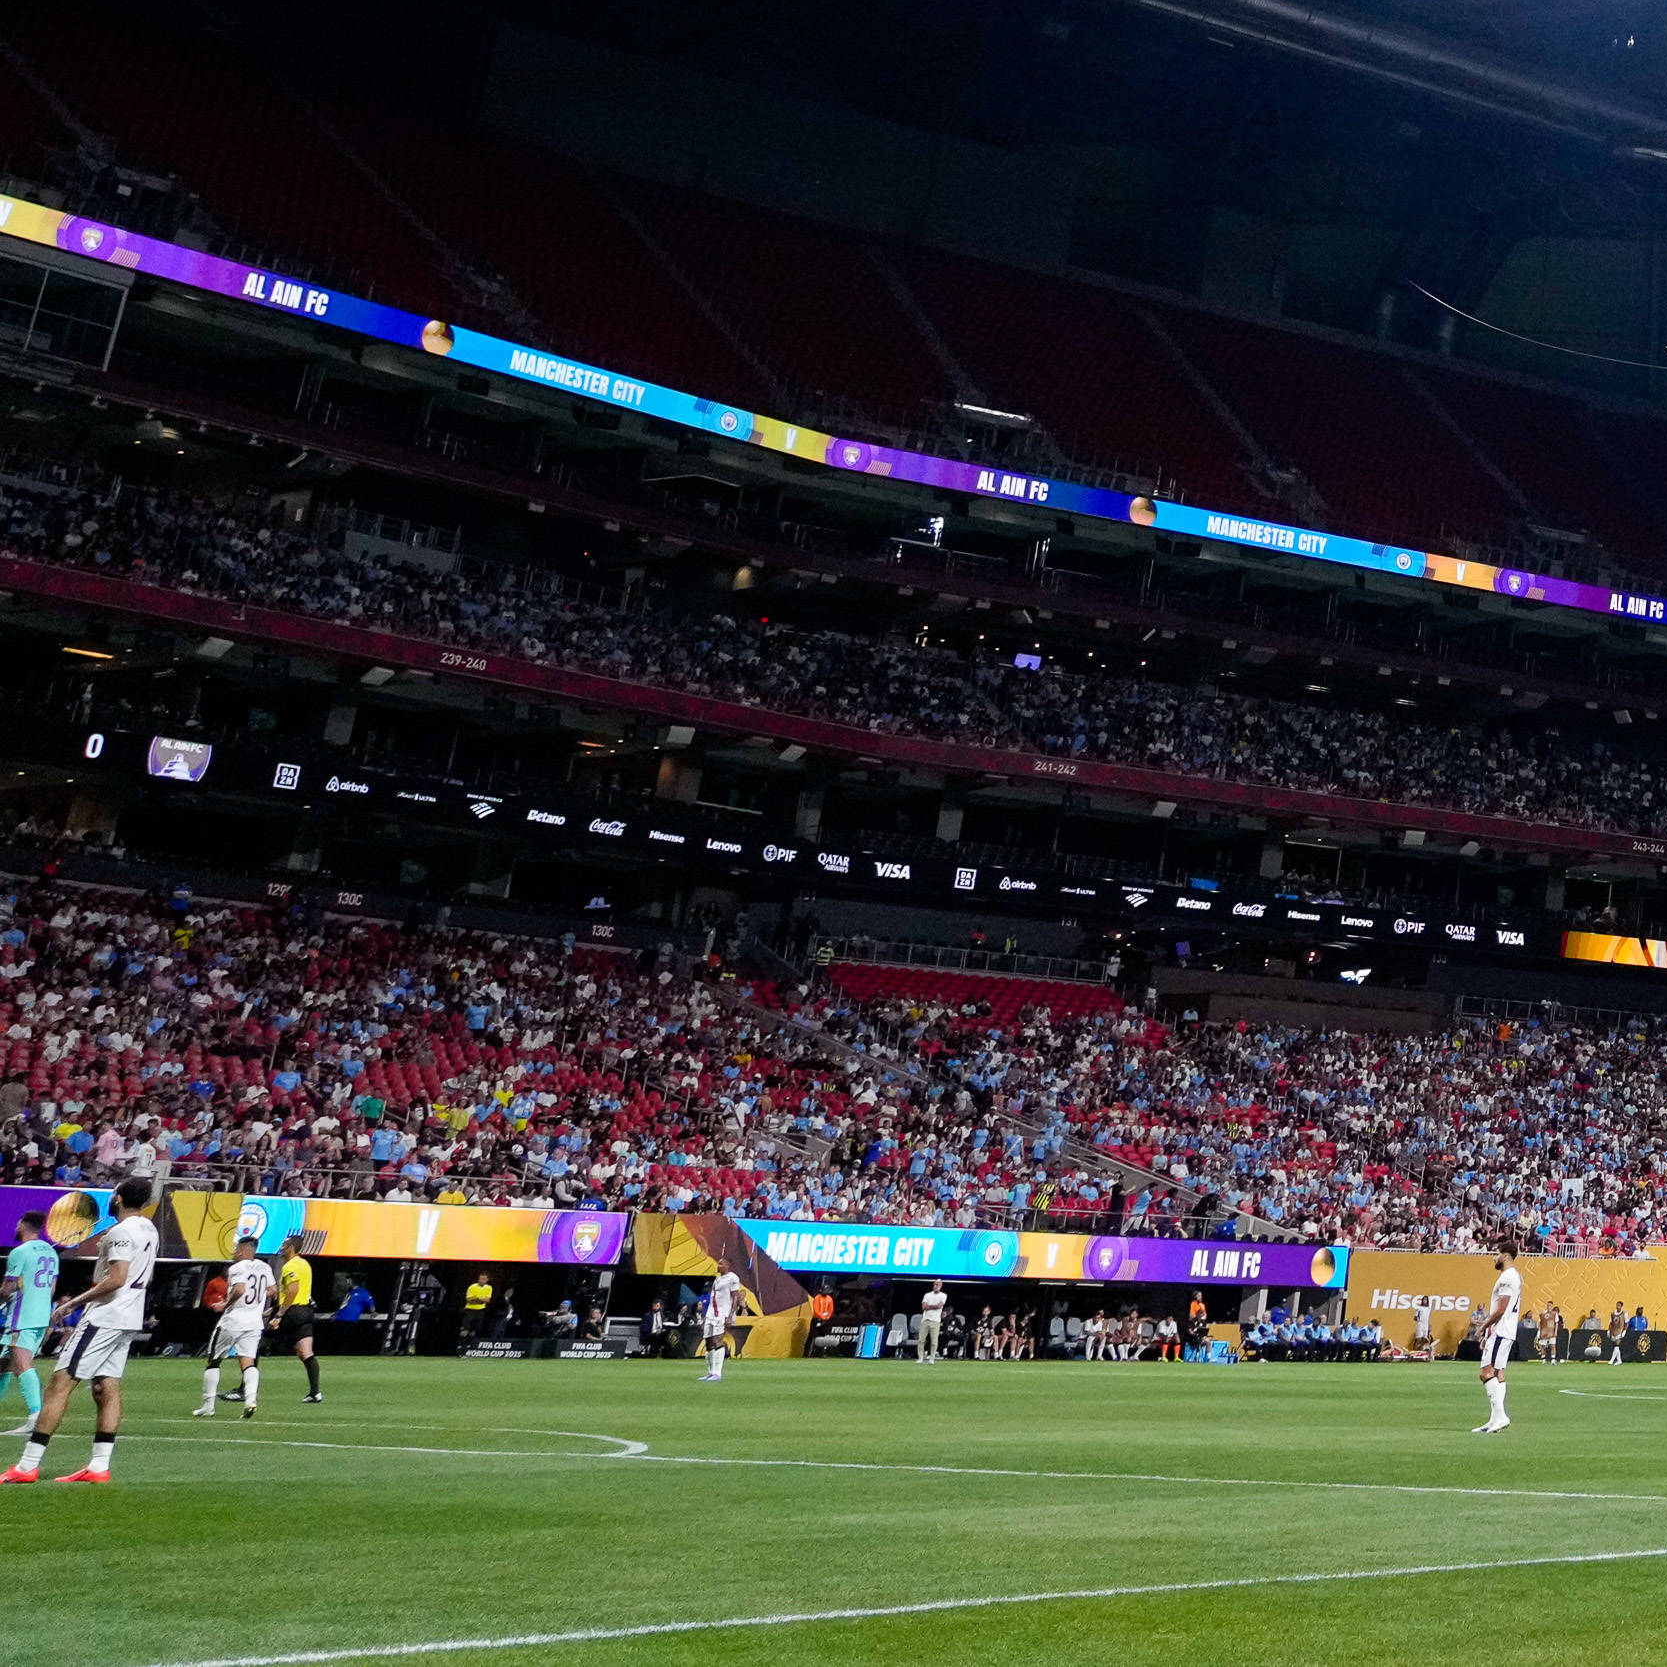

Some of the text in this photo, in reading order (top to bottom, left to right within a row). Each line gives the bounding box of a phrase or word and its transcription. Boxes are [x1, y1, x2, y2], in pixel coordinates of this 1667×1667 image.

[243, 272, 266, 301] AL
[271, 278, 302, 311] AIN
[305, 288, 329, 316] FC
[510, 349, 609, 397] MANCHESTER
[612, 377, 645, 407] CITY
[977, 470, 996, 493] AL
[1000, 473, 1027, 499] AIN
[1029, 479, 1050, 502] FC
[1206, 514, 1296, 550] MANCHESTER
[1299, 531, 1328, 556] CITY
[1609, 592, 1625, 613] AL
[1627, 595, 1648, 617] AIN
[1649, 599, 1665, 620] FC
[526, 809, 798, 863] Betano Hisense Lenovo PIF
[817, 852, 850, 867] QATAR
[874, 861, 1426, 934] VISA Betano Hisense Lenovo PIF
[1445, 924, 1476, 936] QATAR
[1496, 930, 1525, 946] VISA
[765, 1230, 1262, 1280] MANCHESTER CITY AL AIN FC
[244, 1273, 269, 1306] 30
[1370, 1288, 1471, 1312] Hisense
